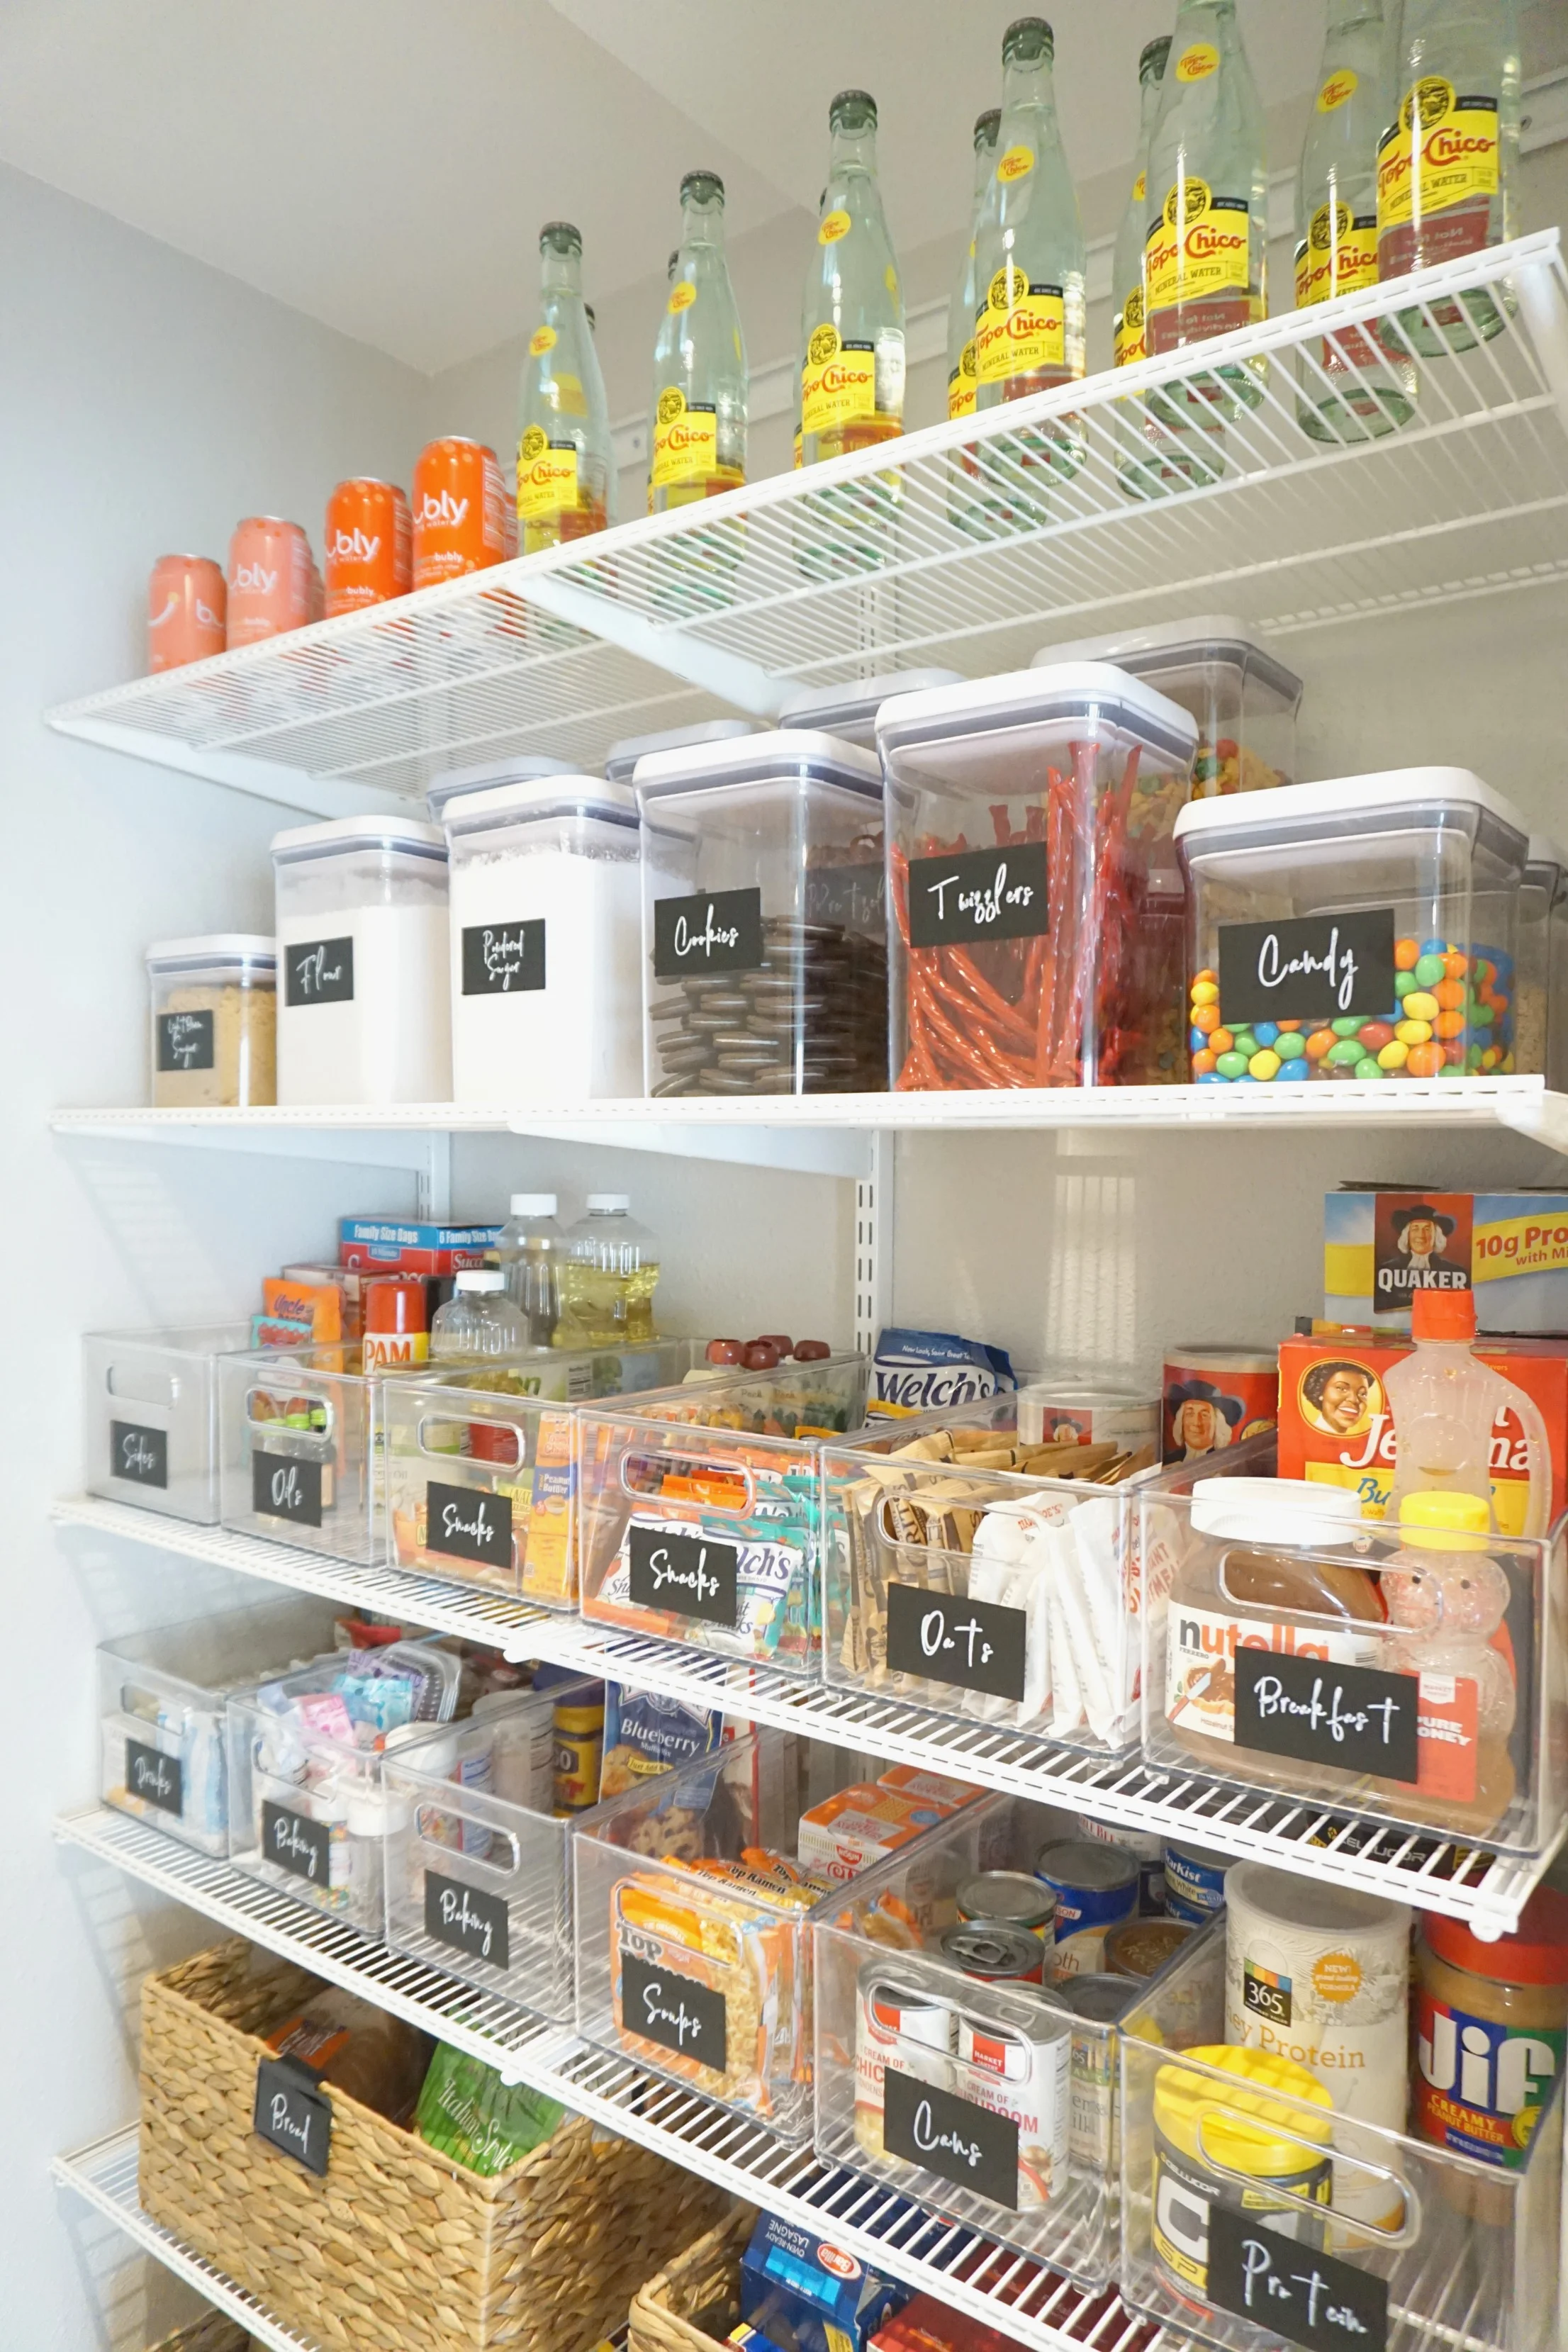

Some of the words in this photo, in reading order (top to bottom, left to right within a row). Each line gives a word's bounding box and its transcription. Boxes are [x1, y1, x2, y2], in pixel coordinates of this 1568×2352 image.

[1421, 128, 1496, 167] Chico
[1432, 174, 1467, 189] WATER
[1146, 241, 1182, 283] Topo
[1185, 224, 1247, 259] Chico
[1155, 271, 1189, 295] MINERAL
[1190, 267, 1222, 279] WATER
[1296, 266, 1326, 306] Topo
[1324, 245, 1378, 280] Chic
[976, 323, 1006, 360] Topo
[1007, 309, 1062, 340] Chico
[982, 350, 1009, 372] MINERAL
[1012, 346, 1040, 358] WATER
[822, 364, 873, 394] Chico
[826, 398, 851, 410] WATER
[668, 424, 715, 451] Chico
[531, 460, 576, 486] Chico
[434, 551, 463, 562] bubly
[346, 585, 374, 596] bubly
[928, 862, 1034, 924] Twizzlers
[482, 929, 525, 964] Powdered
[674, 903, 739, 958] Cookies
[296, 945, 342, 987] Flour
[486, 953, 521, 992] Sugar
[1258, 926, 1359, 1010] Candy
[354, 1224, 379, 1241] Family
[381, 1226, 396, 1242] Size
[439, 1230, 444, 1243] 6
[446, 1230, 471, 1245] Family
[472, 1229, 486, 1243] Size
[1477, 1236, 1519, 1260] 10g
[1516, 1252, 1547, 1266] with
[1378, 1267, 1467, 1292] QUAKER
[274, 1294, 306, 1315] Uncle
[364, 1339, 411, 1372] PAM
[902, 1345, 916, 1353] New
[875, 1371, 990, 1408] Welch's
[123, 1432, 156, 1474] Sides
[271, 1467, 302, 1508] Oils
[442, 1501, 495, 1547] Snacks
[649, 1547, 720, 1602] Snacks
[736, 1546, 791, 1581] lch's
[921, 1610, 994, 1667] Oats
[1180, 1618, 1329, 1662] nutella
[1180, 1646, 1209, 1660] FERRERO
[1253, 1675, 1400, 1743] Breakfast
[621, 1718, 700, 1758] Blueberry
[1417, 1727, 1473, 1747] ONEY
[274, 1817, 318, 1876] Baking
[718, 1877, 757, 1897] Ramen
[746, 1872, 787, 1895] Ramen
[1176, 1879, 1197, 1896] White
[438, 1888, 493, 1956] Baking
[1323, 1964, 1352, 1973] NEW!
[642, 1983, 702, 2046] Soups
[1248, 1981, 1284, 2015] 365
[864, 2046, 890, 2066] CREAM
[893, 2058, 905, 2070] OF
[974, 2050, 1003, 2067] MARKET
[1259, 2024, 1366, 2069] Protein
[1418, 2010, 1556, 2115] Jif
[966, 2081, 995, 2100] CREAM
[997, 2093, 1009, 2104] OF
[270, 2093, 313, 2154] Bread
[437, 2078, 481, 2136] Italian
[471, 2118, 514, 2172] Style
[1427, 2101, 1462, 2129] PEANUT
[1463, 2122, 1505, 2144] BUTTER
[1430, 2093, 1497, 2132] CREAMY
[913, 2100, 982, 2168] Cans
[764, 2231, 805, 2258] OVEN-READY
[768, 2219, 810, 2249] LASAGNE
[820, 2247, 852, 2272] Barilla
[1241, 2238, 1369, 2338] Protein
